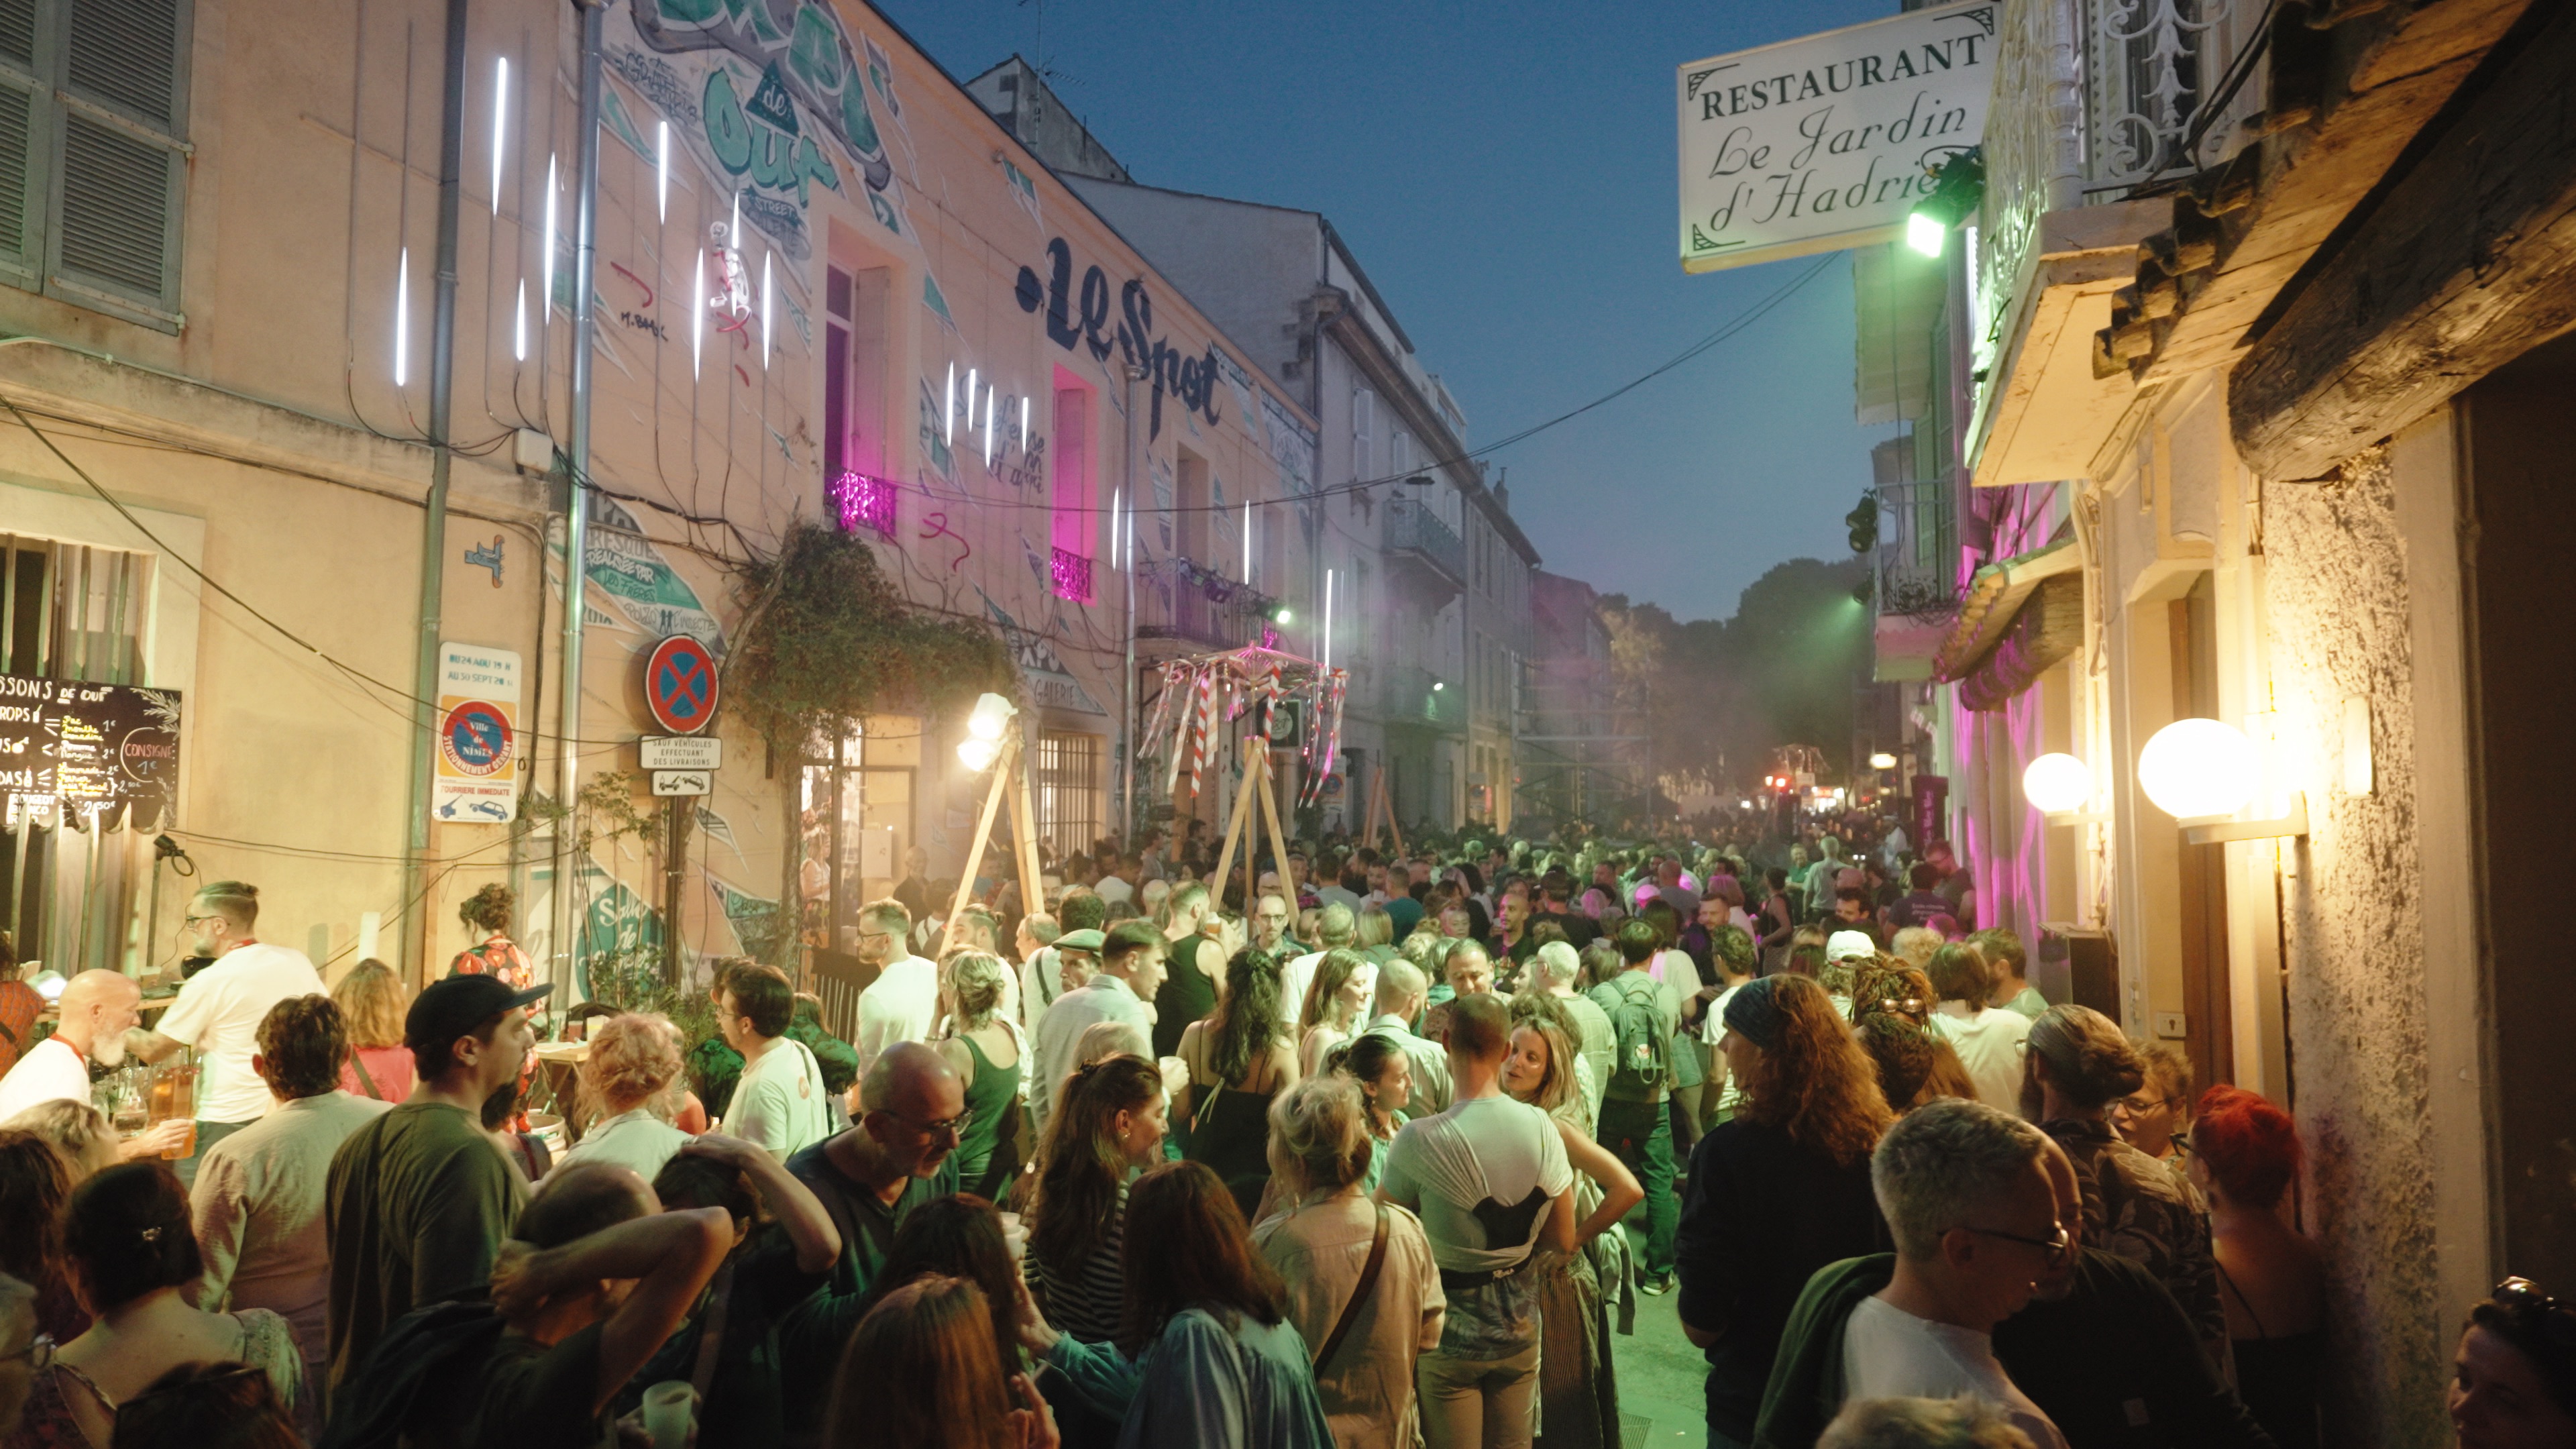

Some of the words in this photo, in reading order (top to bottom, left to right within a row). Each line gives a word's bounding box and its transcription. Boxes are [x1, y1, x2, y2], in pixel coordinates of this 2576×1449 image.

[1701, 32, 1986, 121] RESTAURANT
[763, 85, 788, 116] de
[1708, 126, 1771, 180] Le
[1790, 90, 1967, 170] Jardin
[1709, 155, 1939, 232] d'Hadrie
[755, 196, 794, 217] STREET
[1046, 236, 1115, 363] Le
[1117, 278, 1228, 445] Spot
[586, 529, 663, 562] RESQUE
[635, 564, 655, 584] PAR
[448, 671, 459, 681] AU
[472, 673, 493, 684] SEPT
[60, 688, 76, 698] DE
[80, 689, 108, 702] OUF
[1034, 678, 1075, 706] GALERIE
[470, 722, 489, 732] Ville
[473, 735, 484, 744] de
[124, 743, 172, 759] CONSIGNE
[443, 735, 492, 775] STATIONNEMENT
[661, 749, 704, 757] EFFECTUANT
[137, 760, 158, 775] 1€
